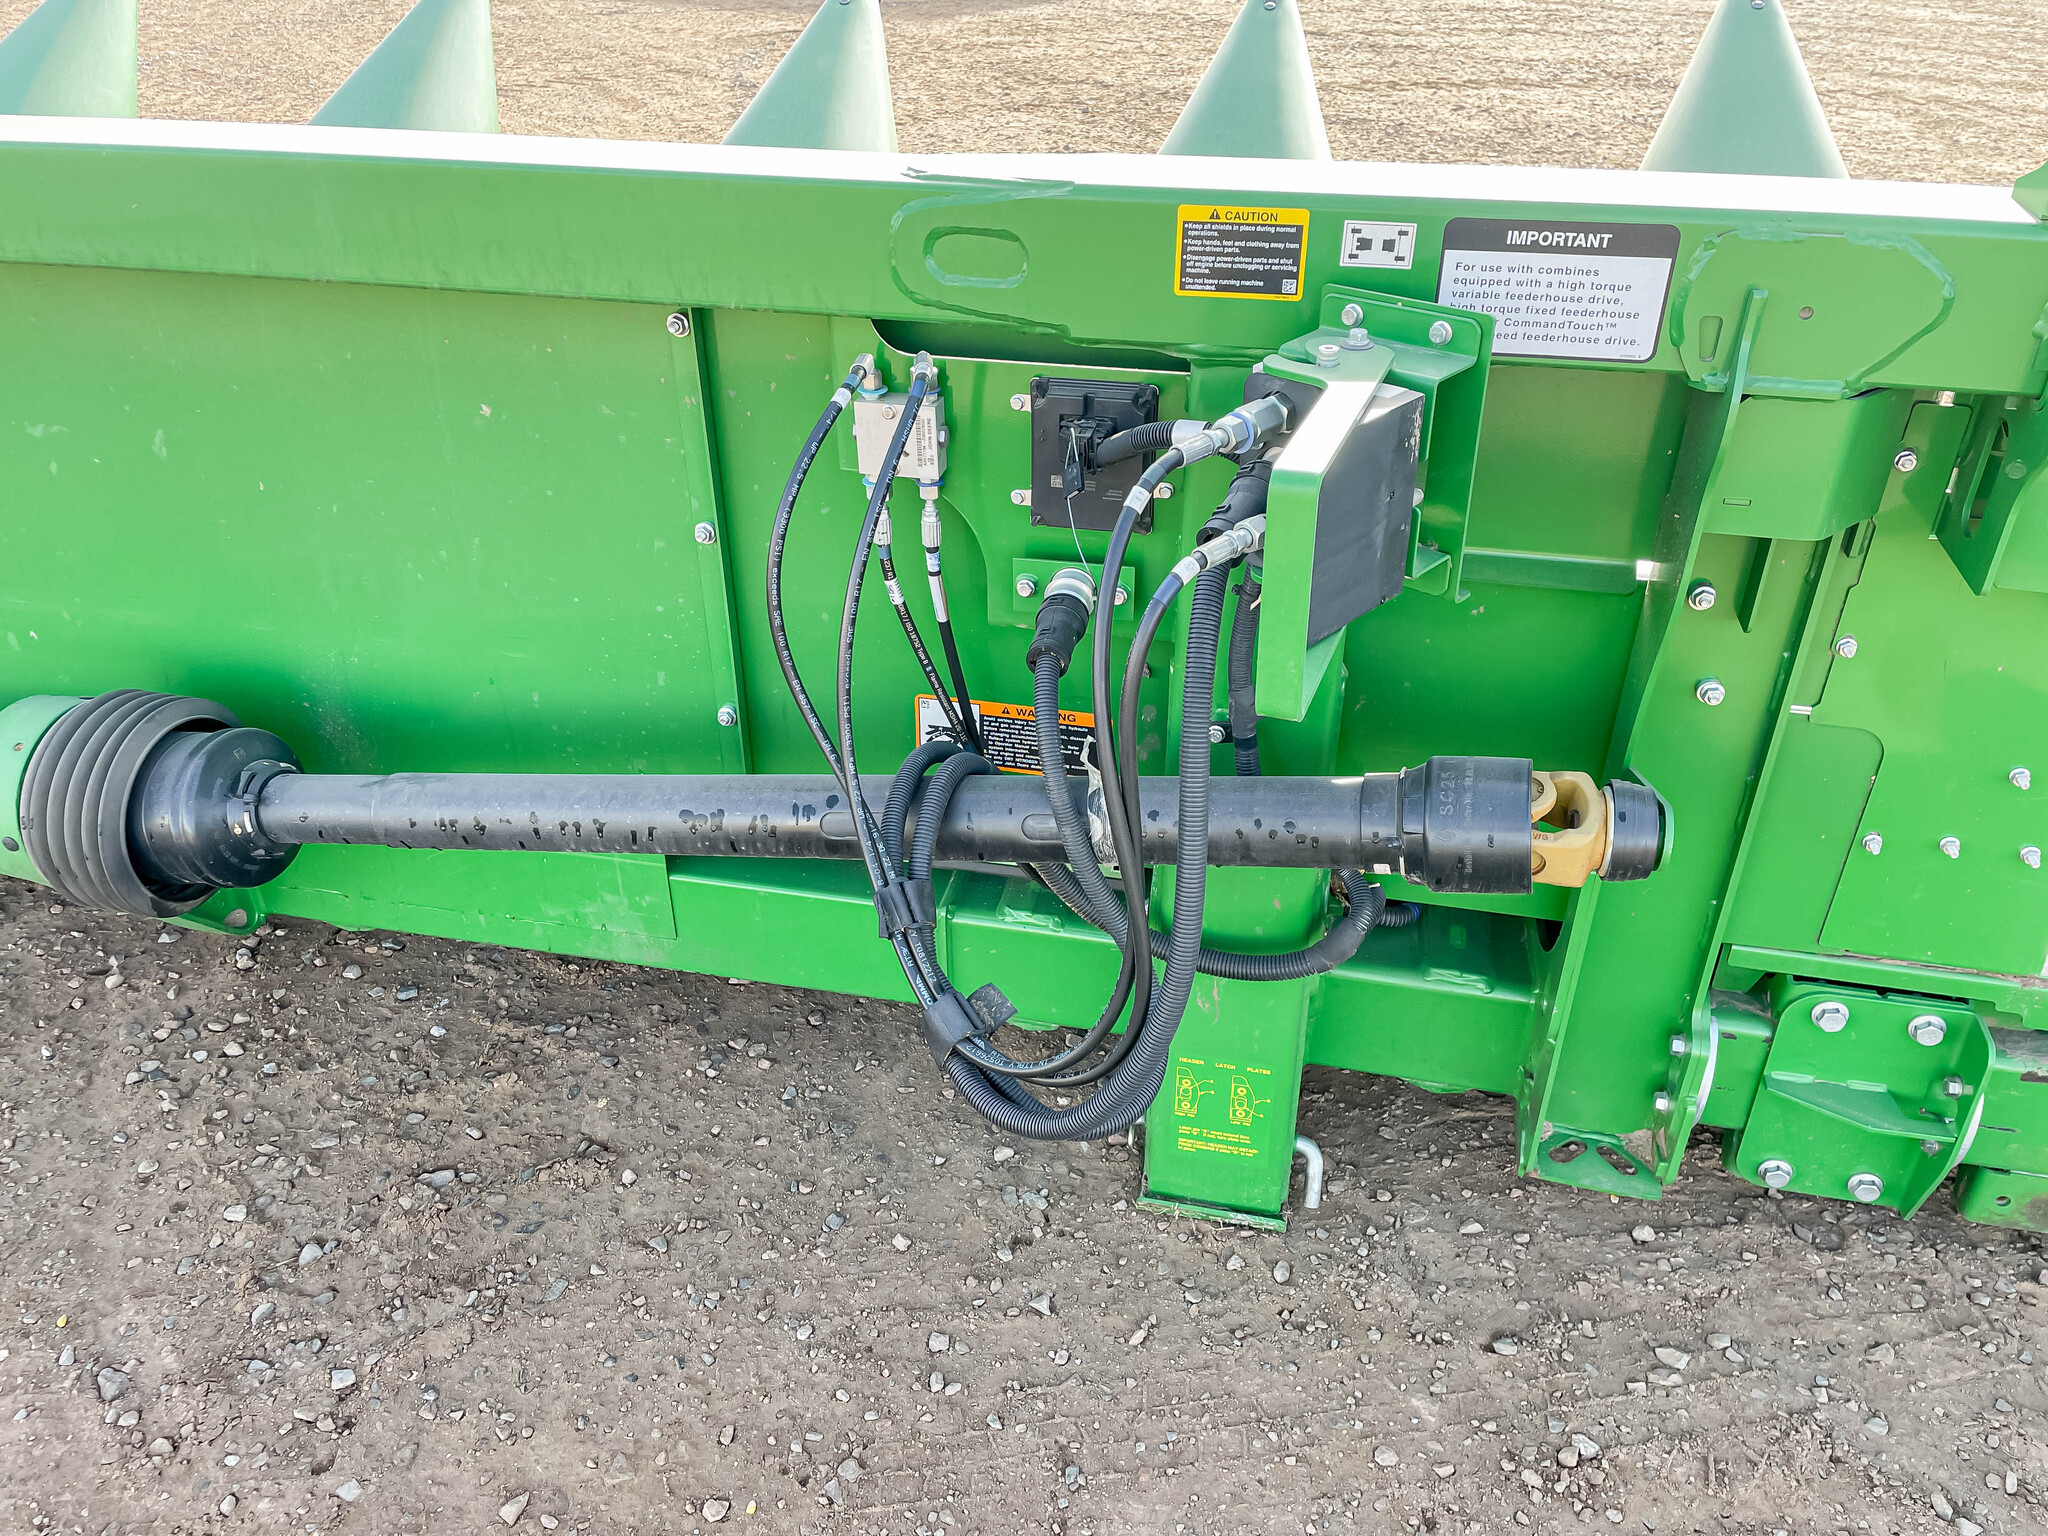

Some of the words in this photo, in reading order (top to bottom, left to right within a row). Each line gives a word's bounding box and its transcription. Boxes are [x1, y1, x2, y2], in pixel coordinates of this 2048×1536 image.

[1225, 211, 1278, 222] CAUTION
[1506, 230, 1613, 249] IMPORTANT
[1187, 254, 1215, 262] Disengage
[1455, 262, 1476, 272] For
[1480, 263, 1502, 273] use
[1507, 263, 1533, 274] with
[1538, 265, 1600, 277] combines
[1453, 277, 1511, 288] equipped
[1515, 278, 1542, 288] with
[1546, 280, 1553, 289] a
[1558, 279, 1585, 291] high
[1590, 282, 1632, 292] torque
[1452, 289, 1500, 299] variable
[1505, 291, 1583, 303] feederhouse
[1588, 295, 1624, 306] drive,
[1481, 304, 1520, 315] torque
[1525, 305, 1556, 316] fixed
[1561, 307, 1640, 319] feederhouse
[1522, 332, 1600, 344] feederhouse
[1605, 336, 1640, 346] drive.
[810, 442, 819, 455] WP
[796, 457, 811, 481] 22.5
[787, 483, 799, 502] MPa
[778, 507, 792, 534] (3300
[774, 539, 784, 562] PSI)
[773, 610, 782, 626] SAE
[776, 632, 787, 647] 100
[781, 650, 793, 666] R17
[792, 679, 801, 692] EN
[798, 690, 810, 709] 857
[929, 673, 939, 689] Flame
[948, 708, 958, 726] MSHA
[1016, 708, 1076, 722] WANG
[822, 739, 833, 752] DN
[1179, 1057, 1205, 1065] HEADER
[1246, 1067, 1271, 1075] PLATES
